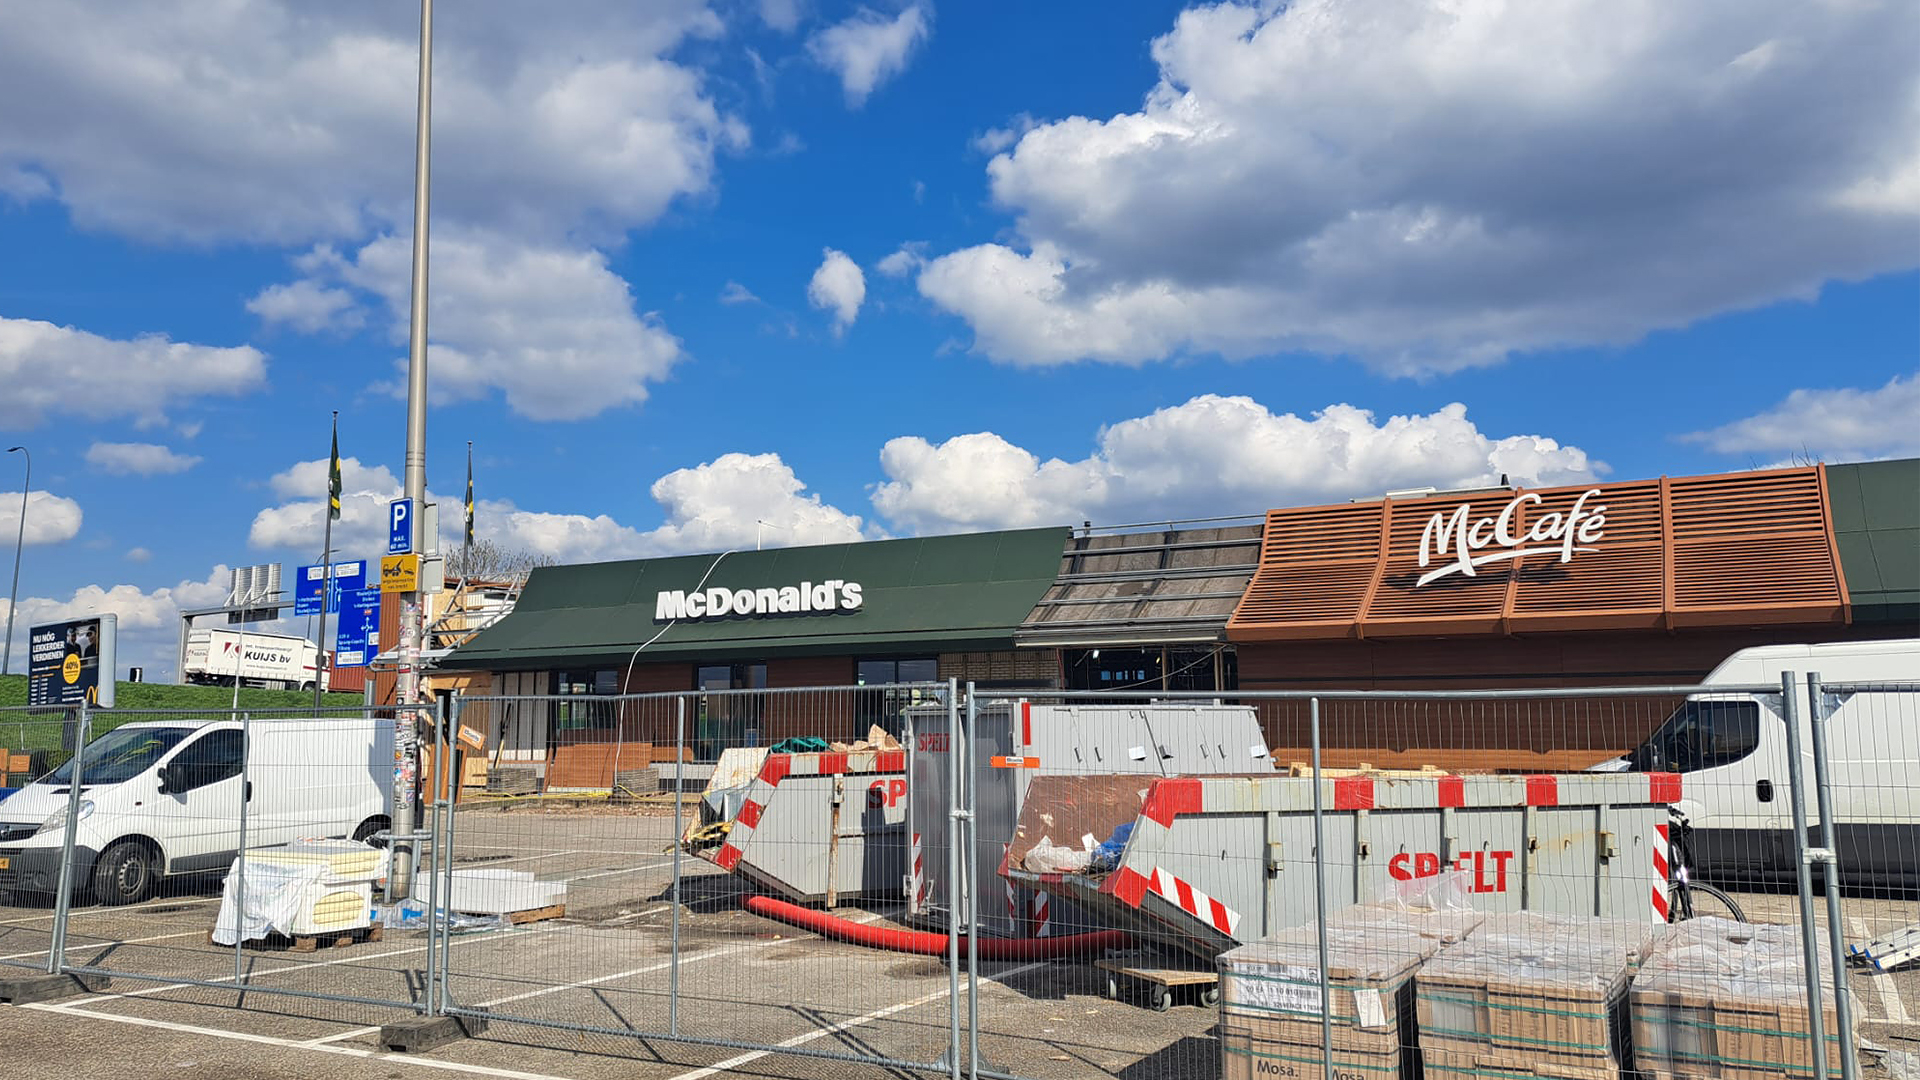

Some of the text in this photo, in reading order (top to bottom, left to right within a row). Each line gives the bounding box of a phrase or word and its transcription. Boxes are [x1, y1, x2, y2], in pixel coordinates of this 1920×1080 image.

[393, 504, 406, 531] P
[1417, 489, 1607, 580] McCafé
[655, 579, 863, 620] McDonald's
[33, 631, 55, 643] NU NÓG
[33, 641, 65, 653] LEKKERDER
[33, 651, 64, 662] VERDIENEN
[244, 650, 291, 663] KUIJS bv
[1257, 1060, 1299, 1078] Mosa.
